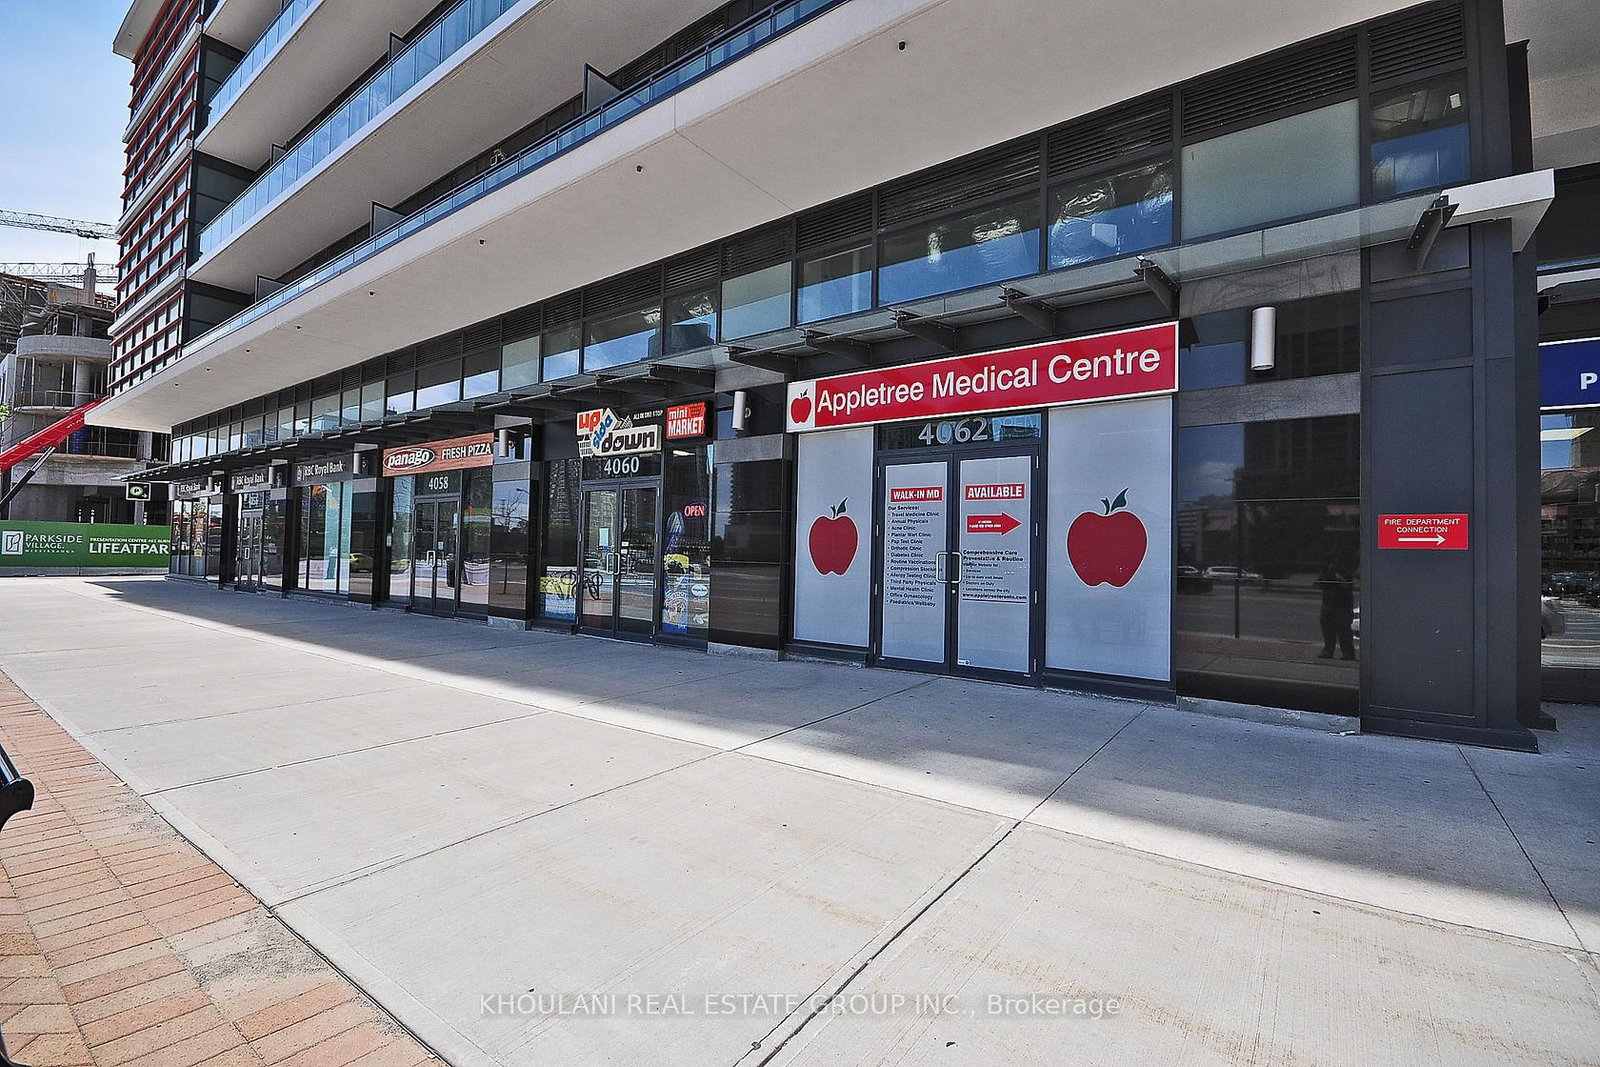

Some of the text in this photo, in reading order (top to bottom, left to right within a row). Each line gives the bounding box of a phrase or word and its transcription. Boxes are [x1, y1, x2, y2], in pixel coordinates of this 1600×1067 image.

[816, 347, 1161, 418] Appletree Medical Centre
[578, 410, 601, 432] up
[652, 410, 664, 418] STOP
[668, 408, 688, 420] mini
[668, 417, 704, 436] MARKET
[918, 417, 989, 445] 4062
[602, 431, 656, 454] down
[387, 450, 430, 468] panago
[441, 443, 492, 460] FRESH PIZZA
[314, 463, 328, 476] Royal
[330, 461, 344, 473] Bank
[603, 456, 640, 475] 4060
[428, 476, 450, 491] 4058
[893, 489, 940, 500] WALK-IN MD
[967, 486, 1022, 498] AVAILABLE
[684, 506, 704, 517] OPEN
[25, 534, 83, 543] PARKSIDE
[89, 543, 169, 554] LIFEATPAR
